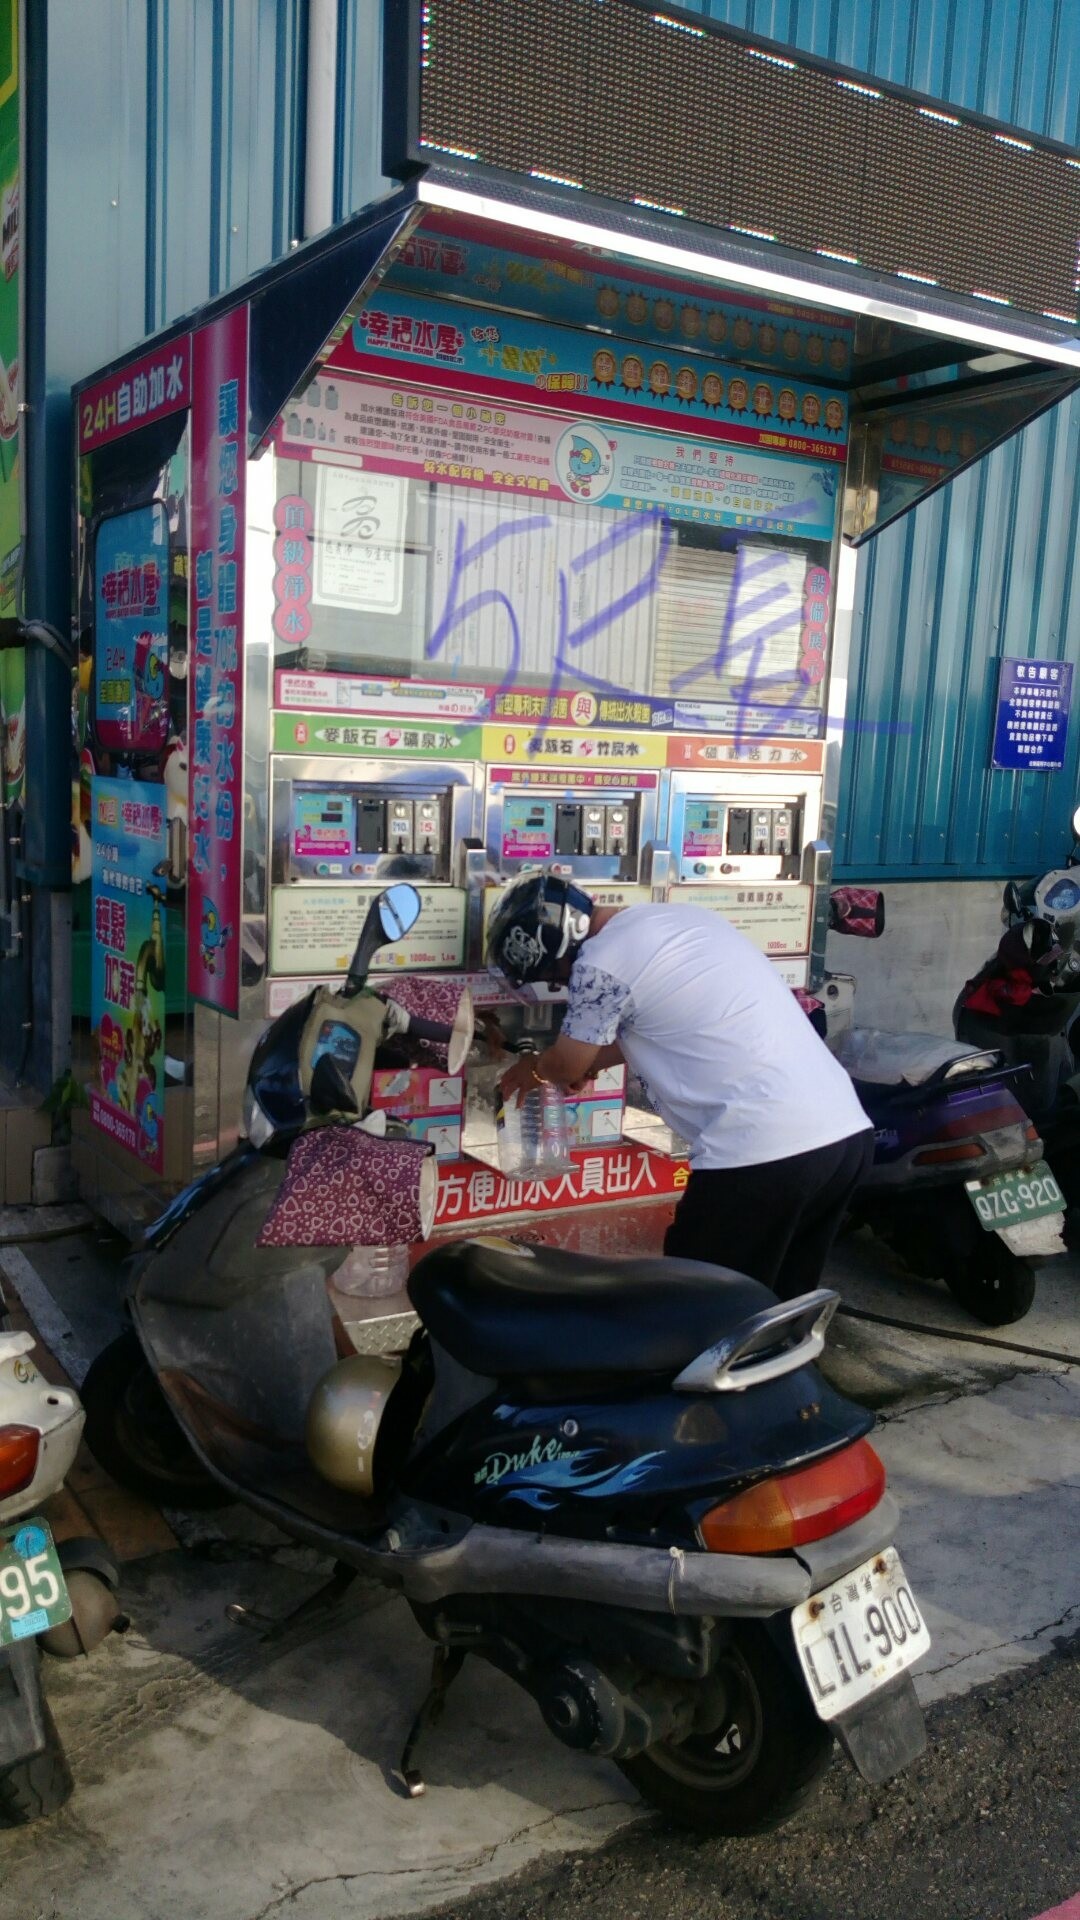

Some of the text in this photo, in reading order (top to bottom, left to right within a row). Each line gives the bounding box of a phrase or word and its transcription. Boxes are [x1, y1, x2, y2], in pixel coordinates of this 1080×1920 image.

[367, 311, 457, 357] 幸福水屋
[367, 338, 434, 356] HAPPY WATER HOUSE
[83, 354, 184, 440] 24H自助加水
[392, 392, 506, 426] 告訴您一個小秘密
[675, 446, 736, 466] 我們堅持
[788, 436, 837, 456] 0800-365178
[423, 459, 550, 492] 好水配好桶 安全又健康
[284, 504, 305, 634] 頂級淨水
[102, 562, 160, 606] 幸福水屋
[808, 574, 827, 677] 設備展示
[1016, 665, 1059, 681] 敬告顧客
[1013, 686, 1059, 698] 本停車場只提供
[575, 697, 593, 720] 與
[1014, 709, 1054, 721] 不負保管責任
[324, 727, 378, 746] 麥飯石
[404, 731, 454, 749] 礦泉水
[597, 741, 639, 757] 竹炭水
[1017, 744, 1044, 754] 謝謝合作
[410, 953, 436, 962] 1000cc
[437, 1151, 657, 1217] 方便加水人員出入
[485, 1434, 558, 1486] Duke
[0, 1553, 60, 1618] 95
